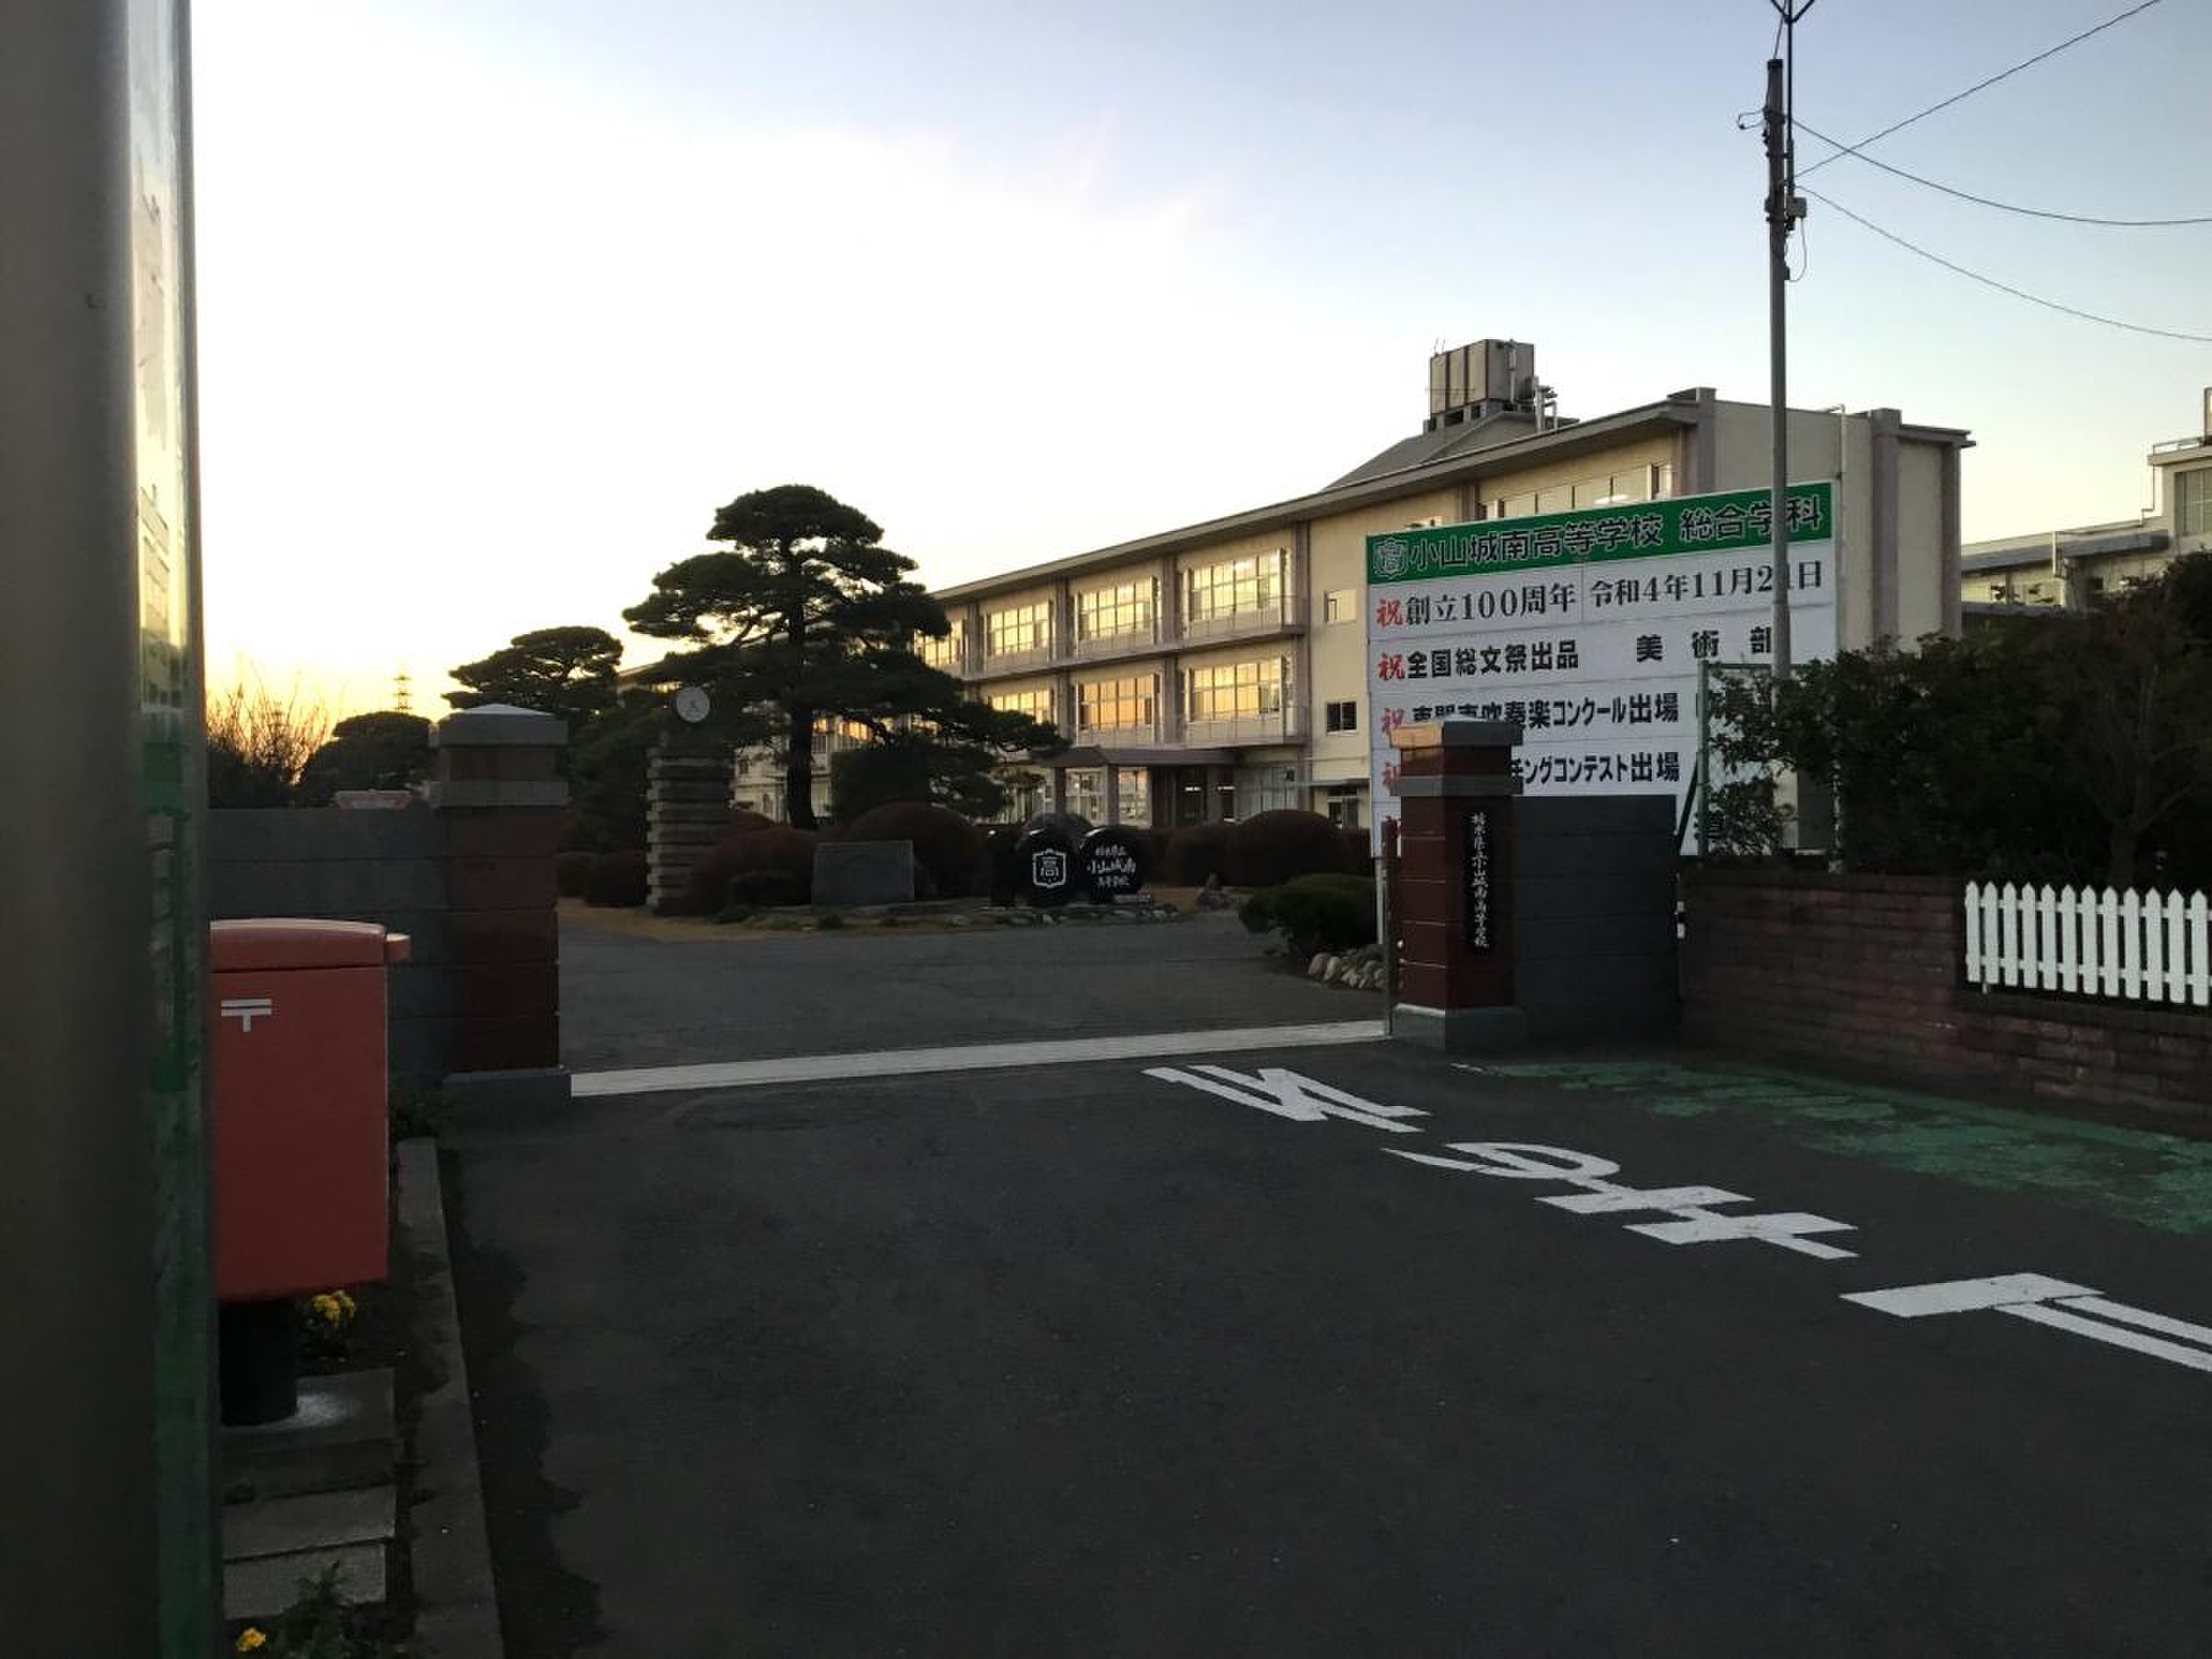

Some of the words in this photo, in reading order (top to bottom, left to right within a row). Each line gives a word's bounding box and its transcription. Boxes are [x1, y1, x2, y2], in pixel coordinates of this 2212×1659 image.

[1410, 514, 1663, 571] 小山城南高等学校
[1680, 495, 1821, 542] 総合学科
